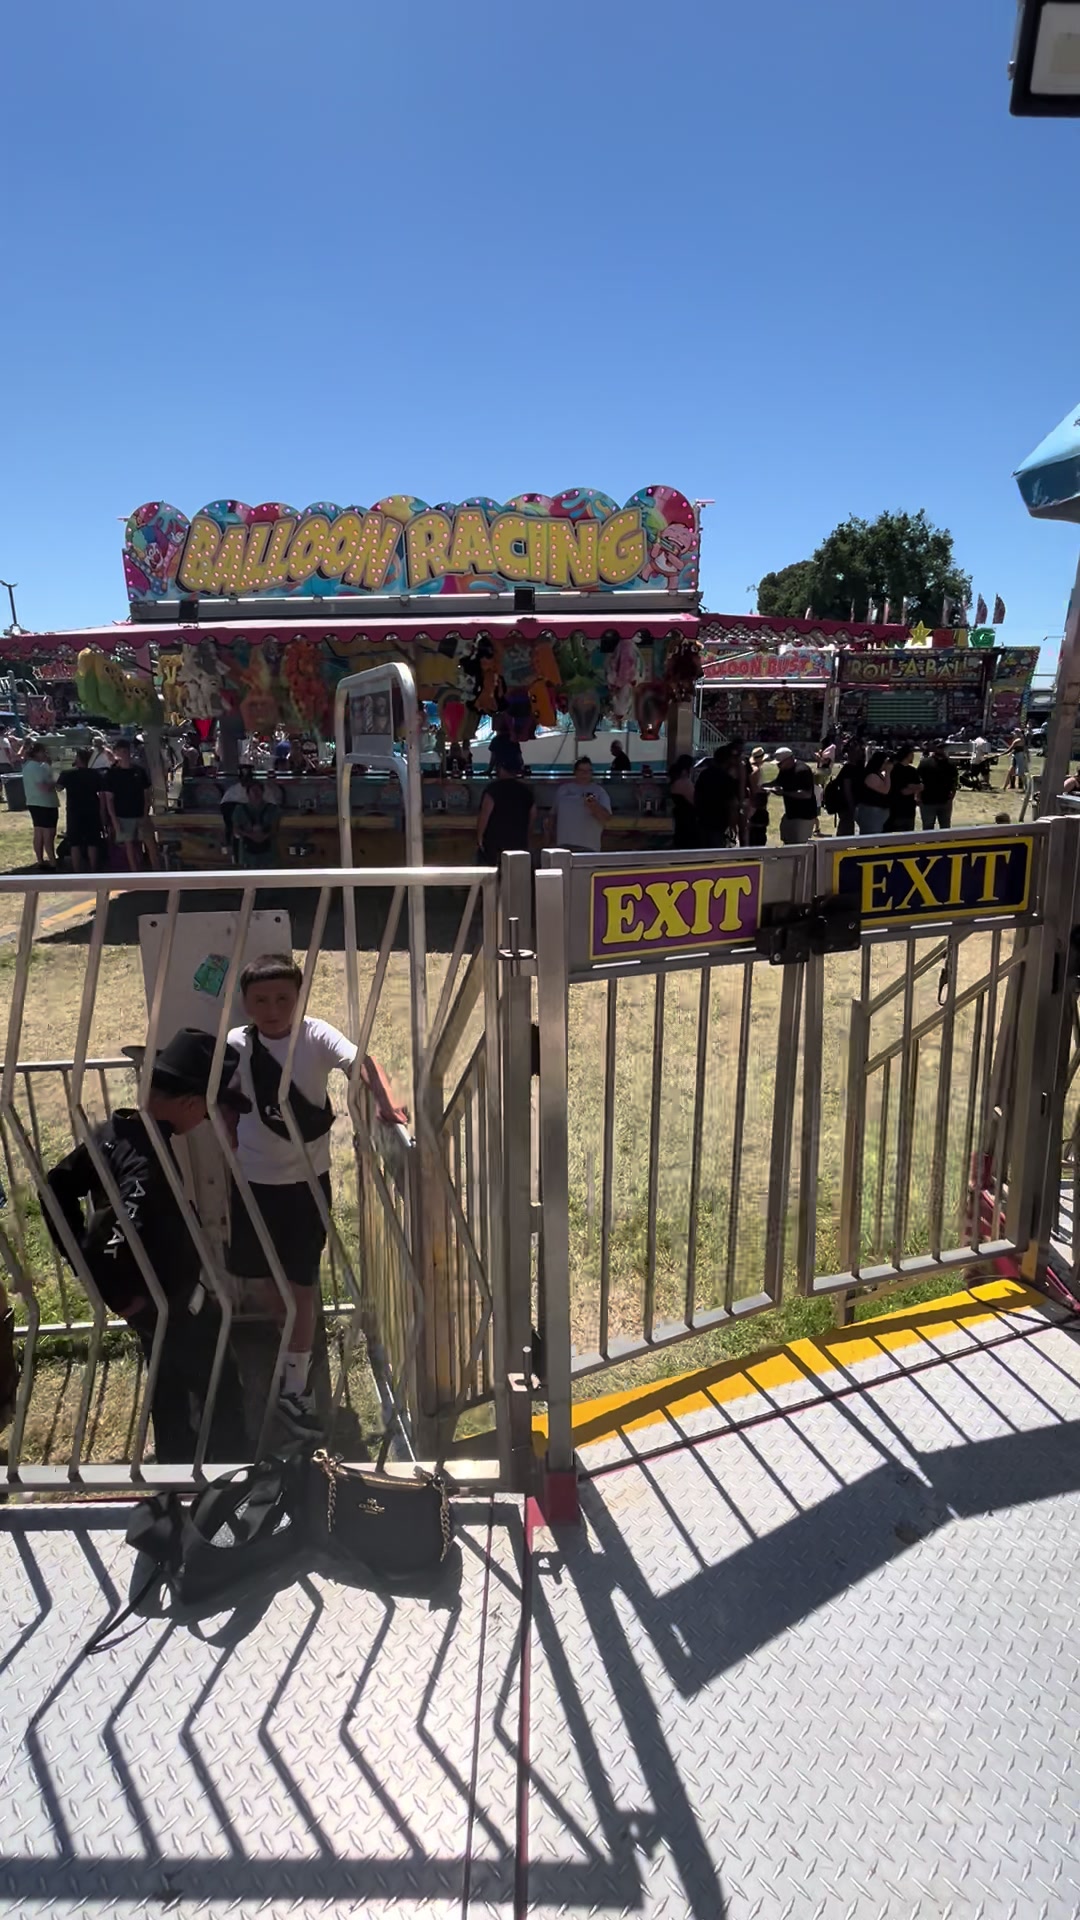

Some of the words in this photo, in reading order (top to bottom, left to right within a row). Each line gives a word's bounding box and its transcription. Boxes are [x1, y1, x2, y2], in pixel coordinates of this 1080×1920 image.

[176, 510, 402, 594] BALLOON
[404, 507, 648, 589] RACING
[602, 874, 752, 945] EXIT
[858, 849, 1011, 913] EXIT
